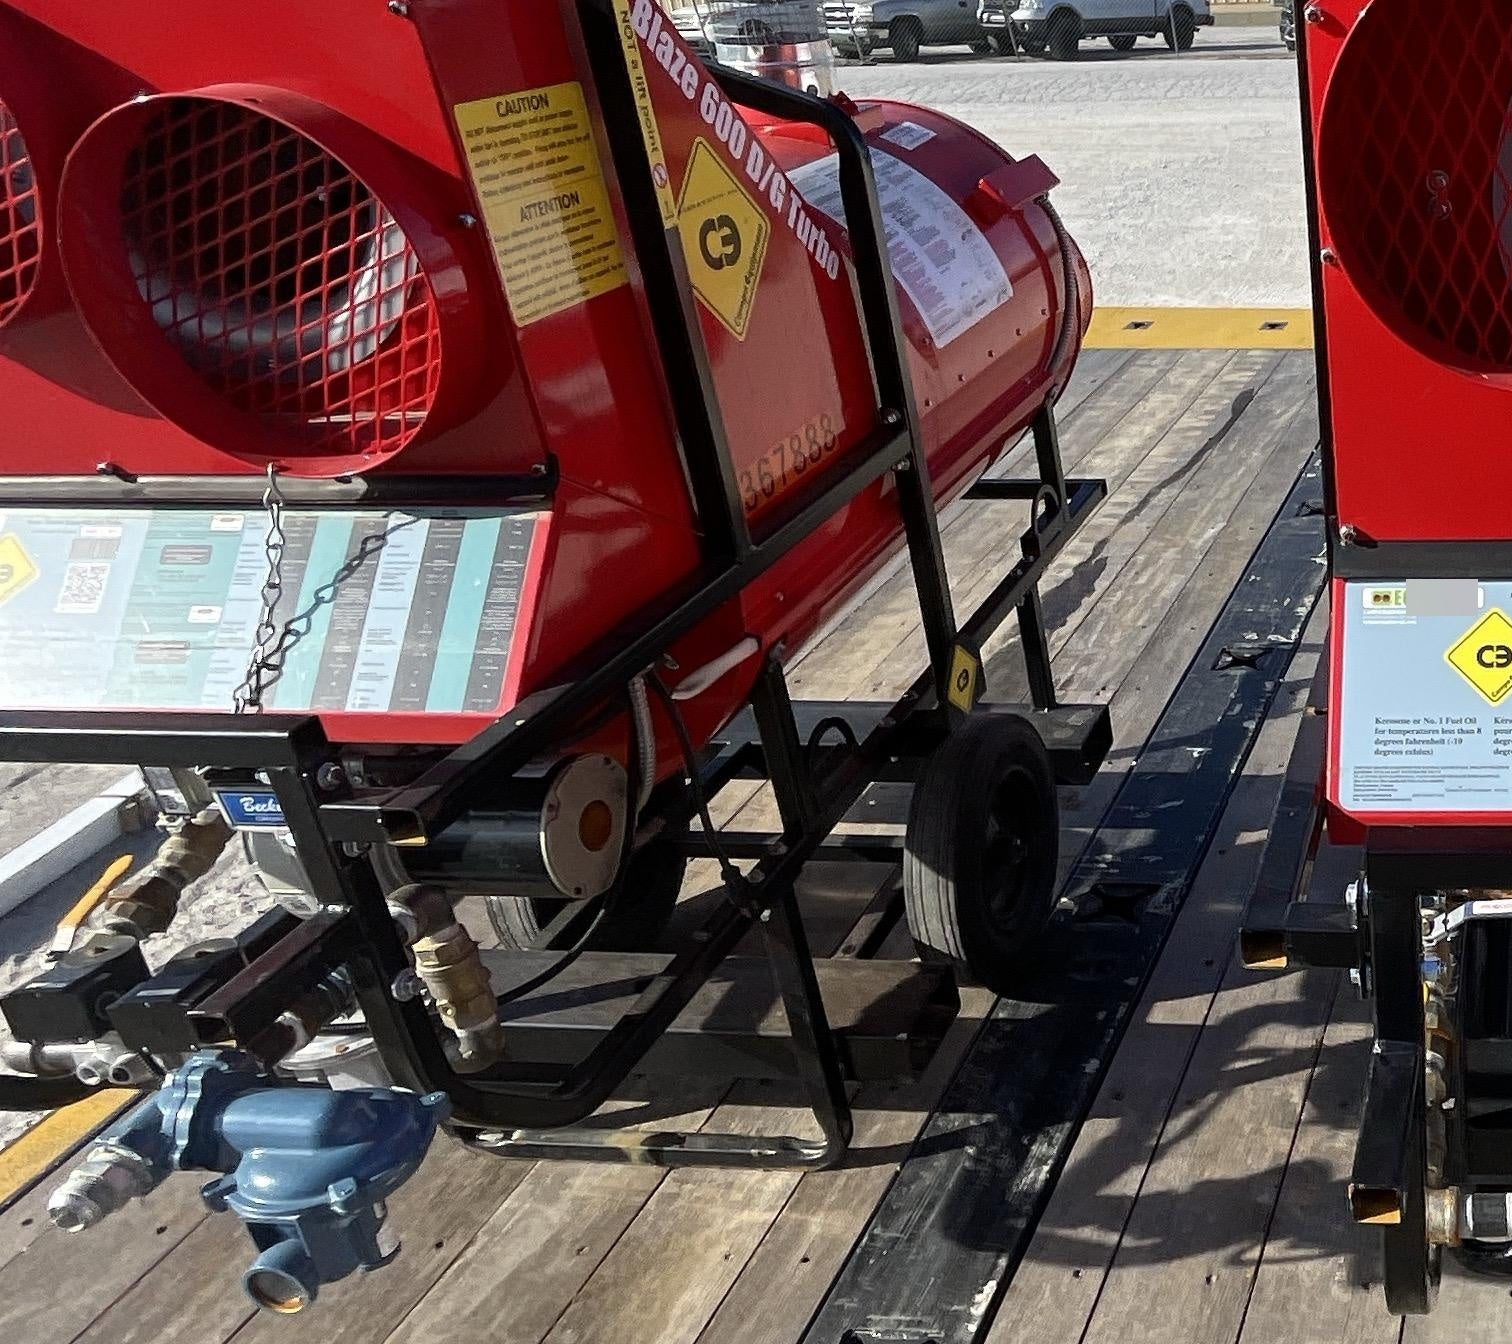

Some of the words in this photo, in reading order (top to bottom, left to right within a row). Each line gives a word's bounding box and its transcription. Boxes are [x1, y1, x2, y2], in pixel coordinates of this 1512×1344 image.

[619, 9, 638, 52] NOT
[638, 104, 659, 153] point
[495, 92, 550, 118] CAUTION
[699, 81, 747, 160] 600
[745, 140, 787, 214] D/G
[786, 188, 840, 281] Turbo
[519, 190, 581, 223] ATTENTION
[1374, 717, 1411, 725] Kerosene
[1445, 717, 1463, 725] Fuel
[1463, 717, 1477, 725] Oil
[1388, 728, 1440, 736] temperatures
[1457, 727, 1475, 735] than
